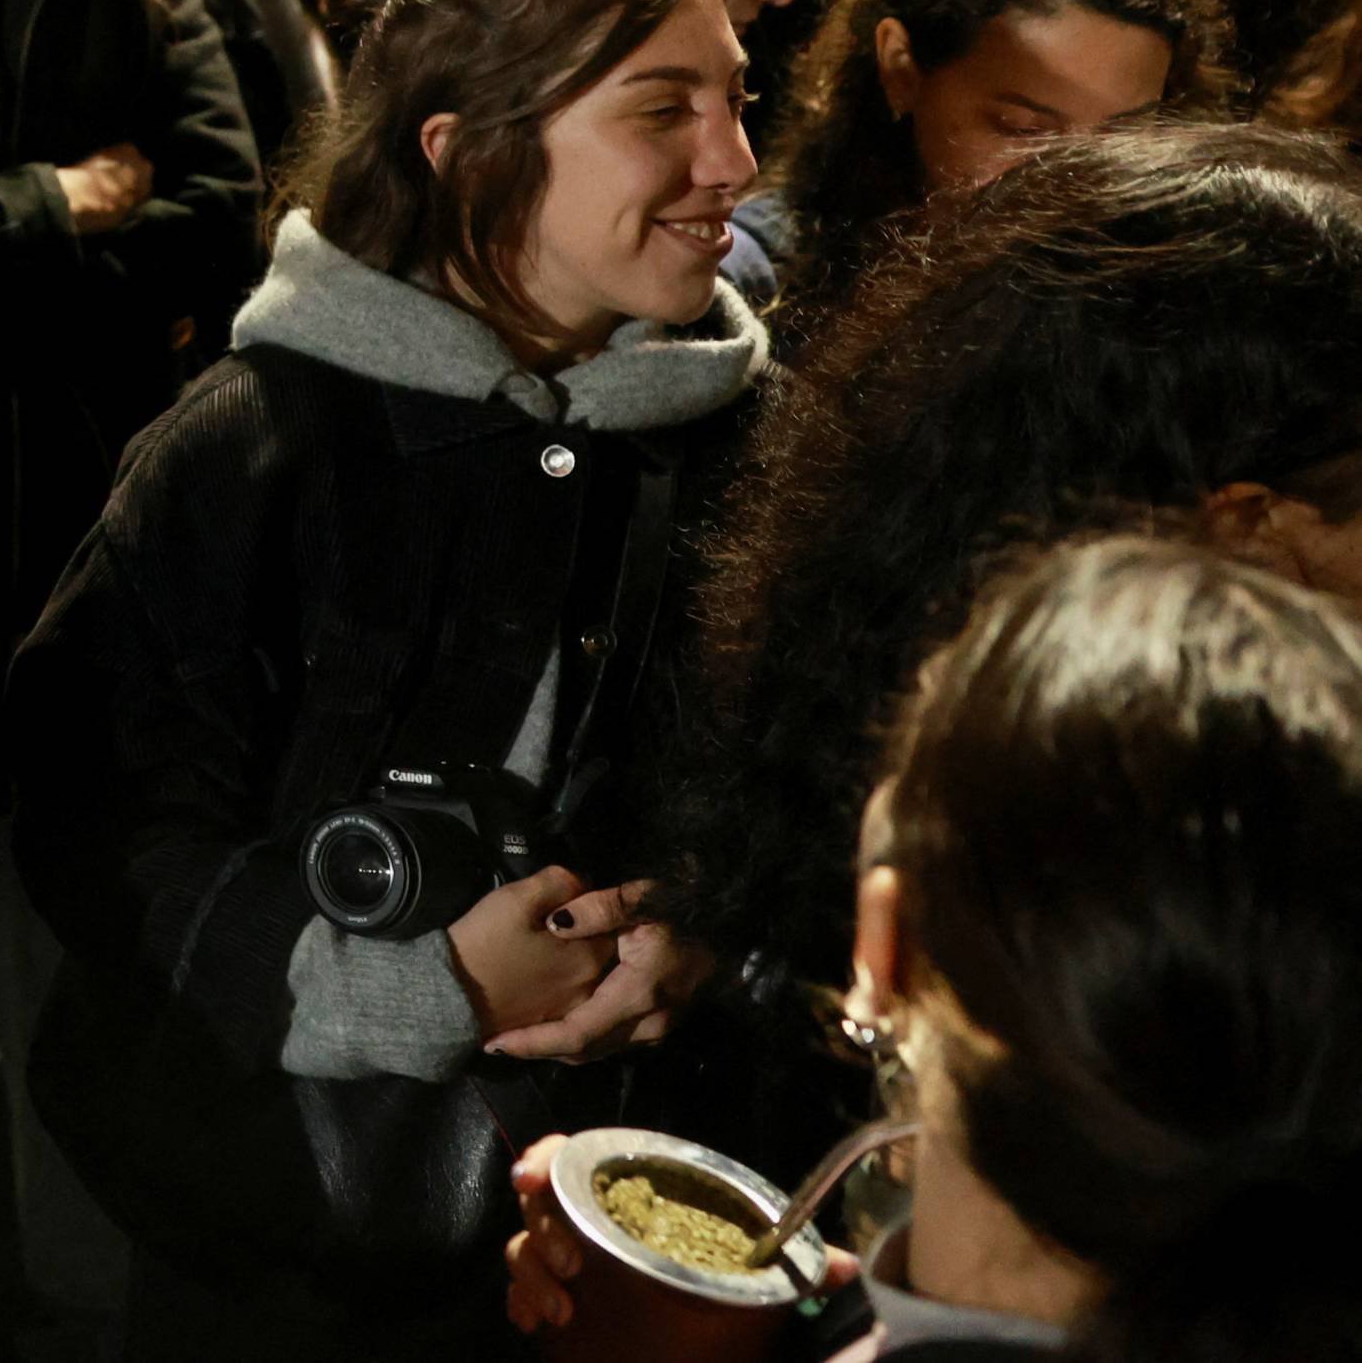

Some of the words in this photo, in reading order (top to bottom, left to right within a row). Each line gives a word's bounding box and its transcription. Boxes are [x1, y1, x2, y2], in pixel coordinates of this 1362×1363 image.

[388, 769, 433, 785] Canon
[503, 834, 525, 845] EOS
[503, 844, 529, 854] 2000D
